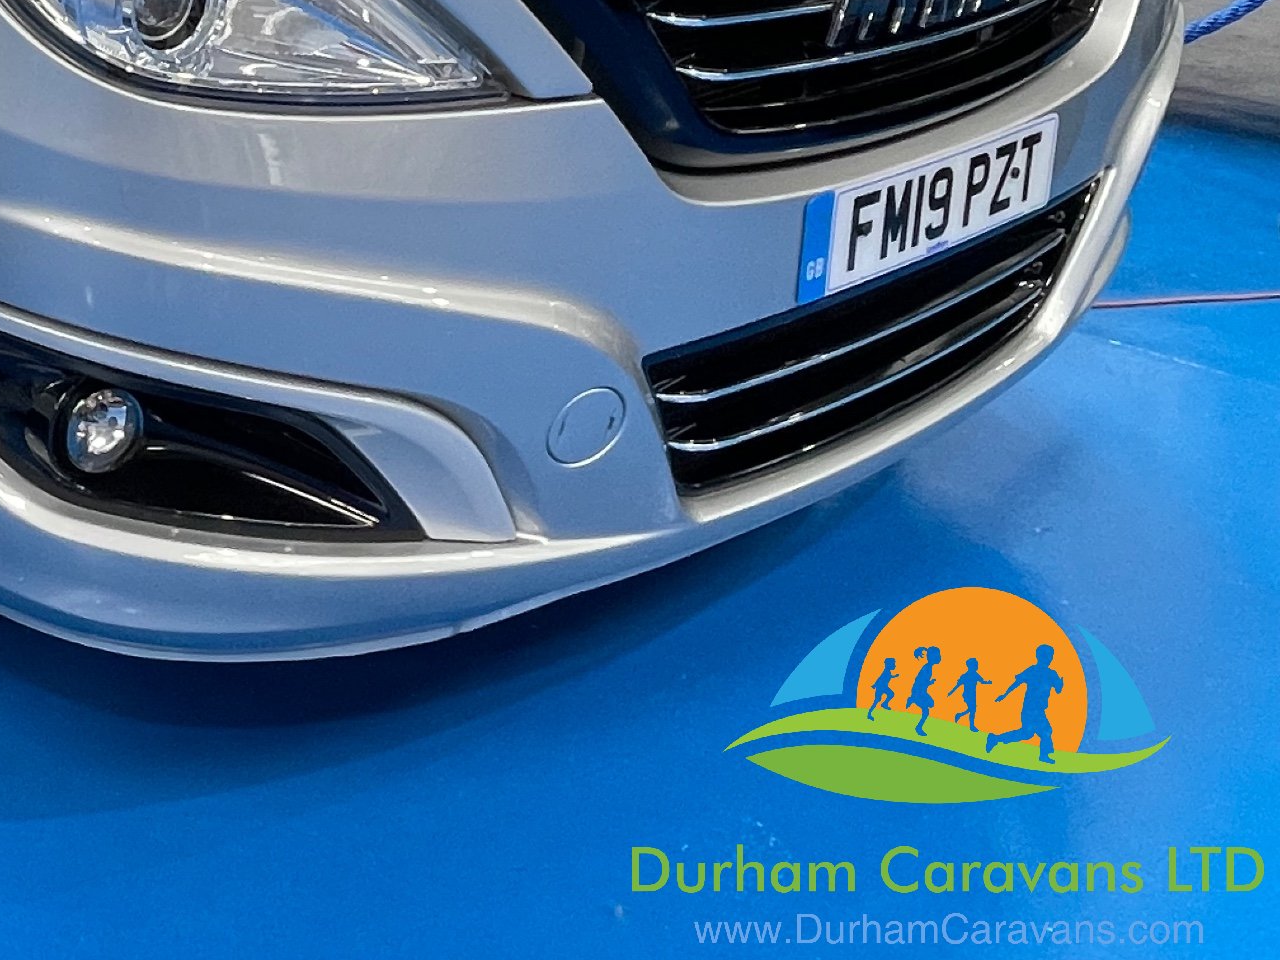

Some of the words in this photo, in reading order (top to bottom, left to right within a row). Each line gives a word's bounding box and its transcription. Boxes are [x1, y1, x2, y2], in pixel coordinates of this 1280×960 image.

[846, 165, 954, 272] FM19
[962, 130, 1043, 228] PZT
[806, 257, 824, 281] GB
